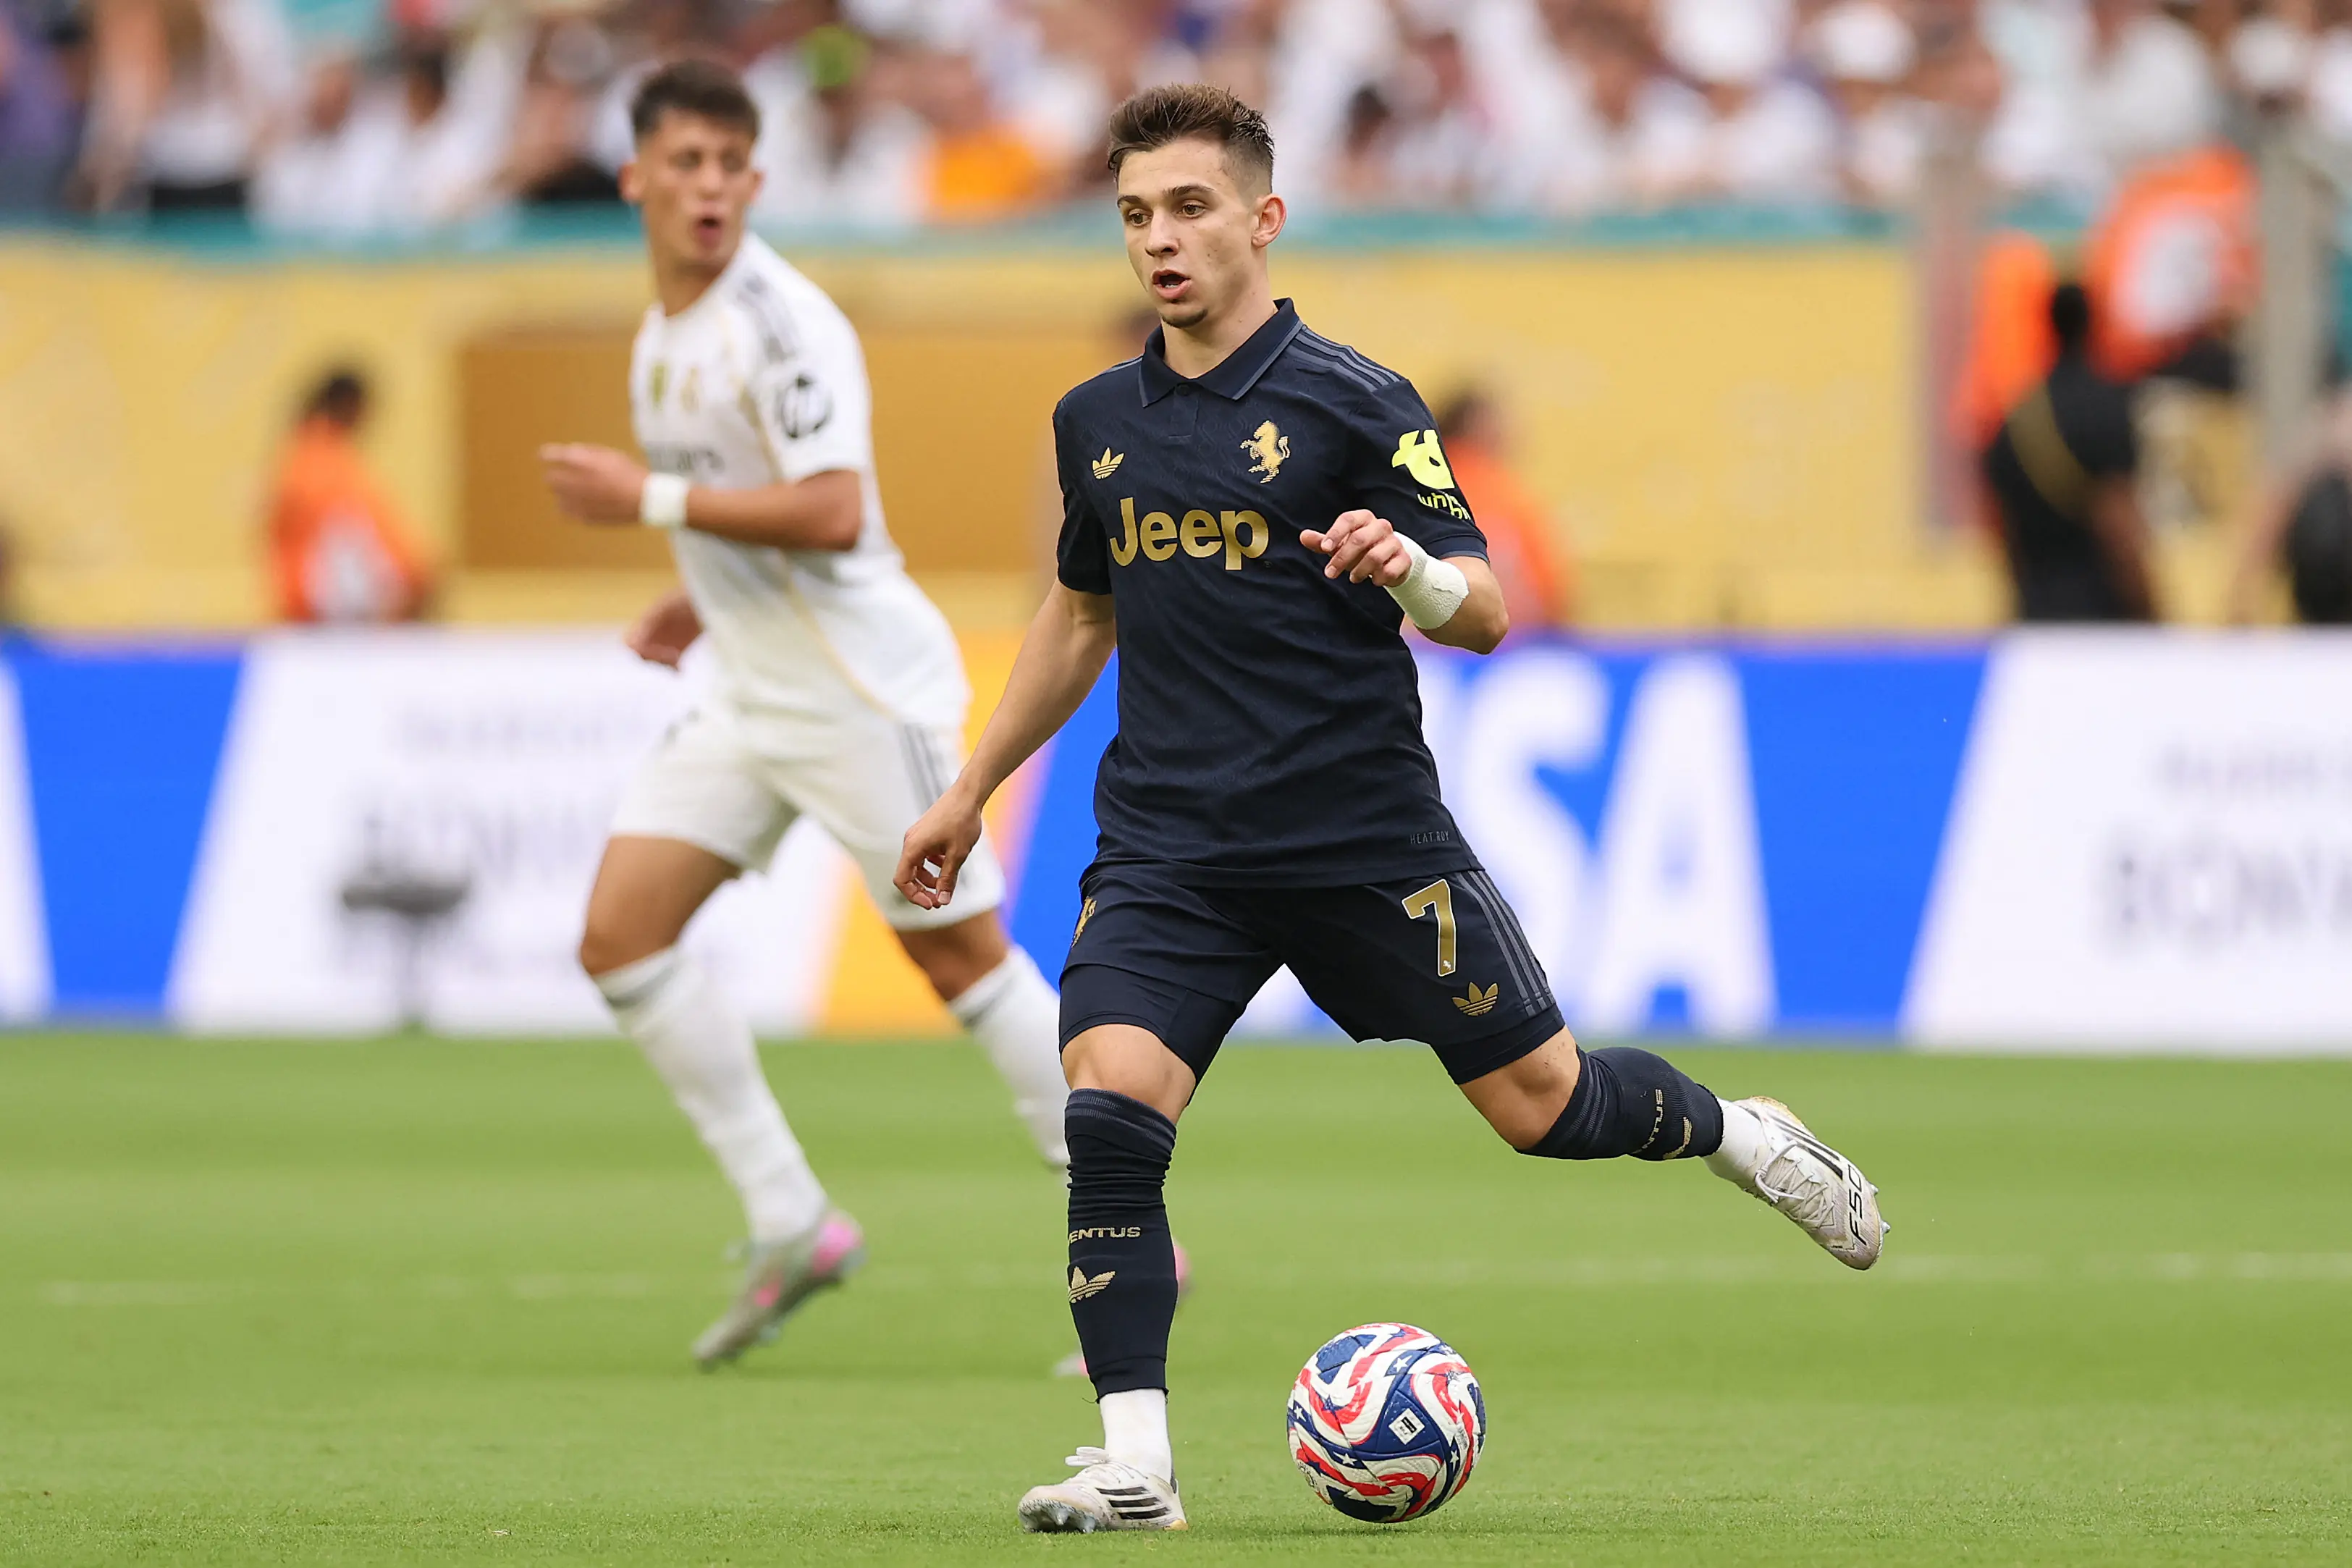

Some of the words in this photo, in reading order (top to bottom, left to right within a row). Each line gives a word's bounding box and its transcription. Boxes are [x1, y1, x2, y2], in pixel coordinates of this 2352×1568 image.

[1110, 497, 1270, 570] Jeep
[1415, 648, 1782, 1034] SA
[1401, 878, 1457, 977] 7
[1847, 1163, 1868, 1247] F50
